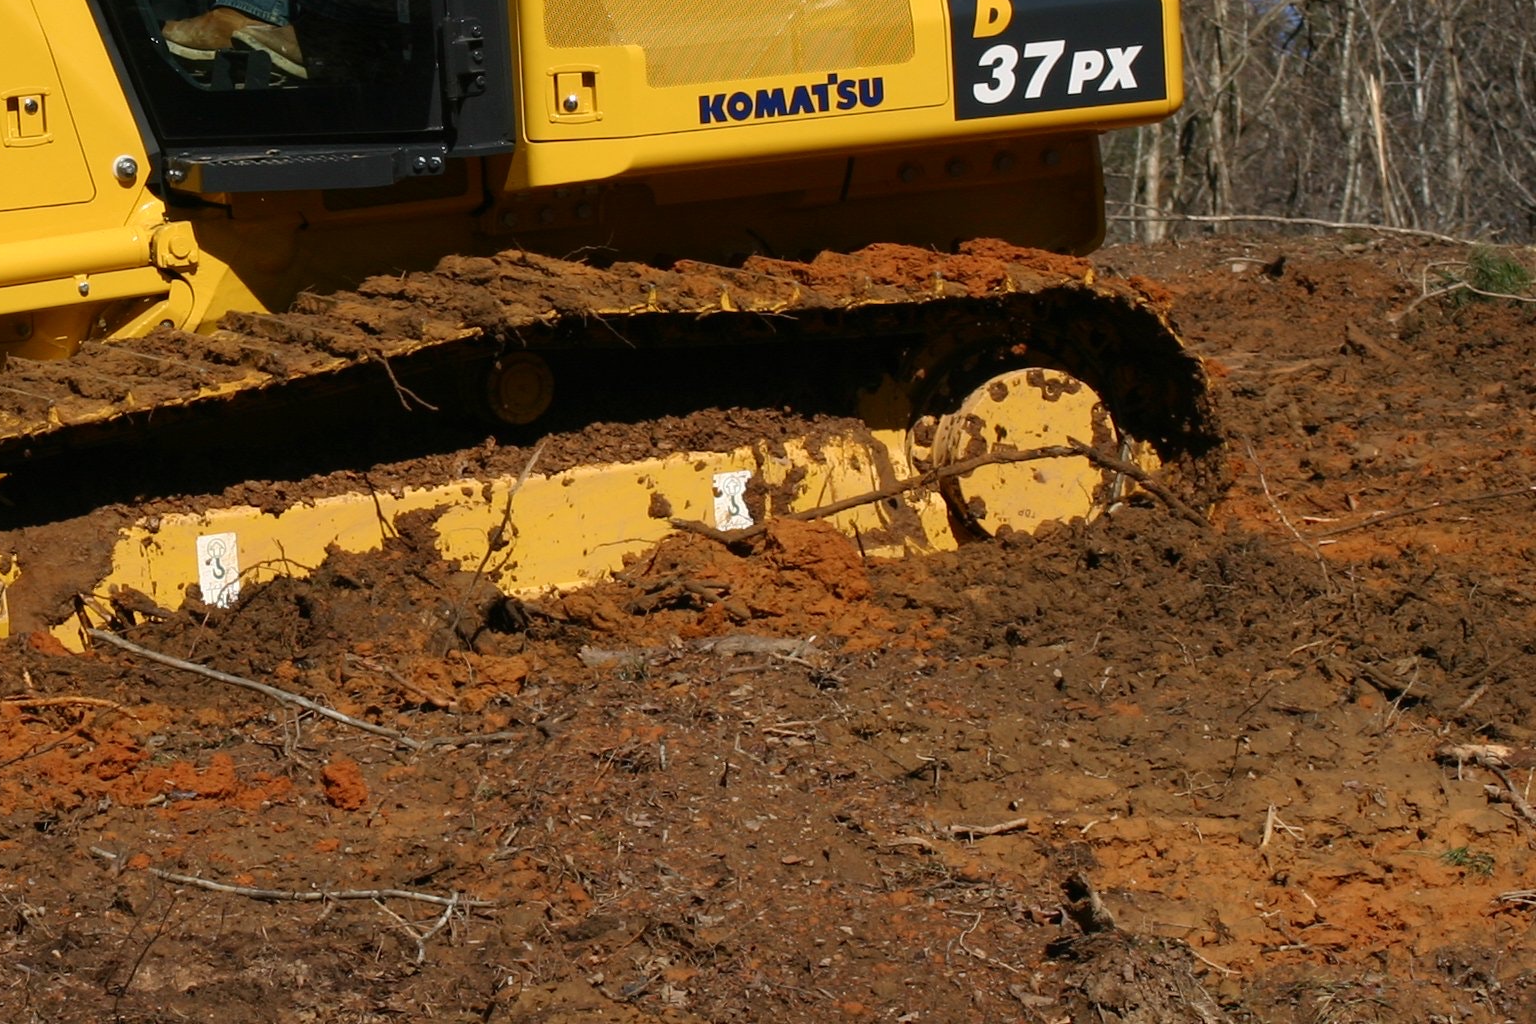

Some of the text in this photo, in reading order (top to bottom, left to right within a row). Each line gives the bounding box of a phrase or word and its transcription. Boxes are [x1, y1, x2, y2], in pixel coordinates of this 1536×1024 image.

[699, 73, 885, 125] KOMATSU
[972, 39, 1144, 105] 37 PX
